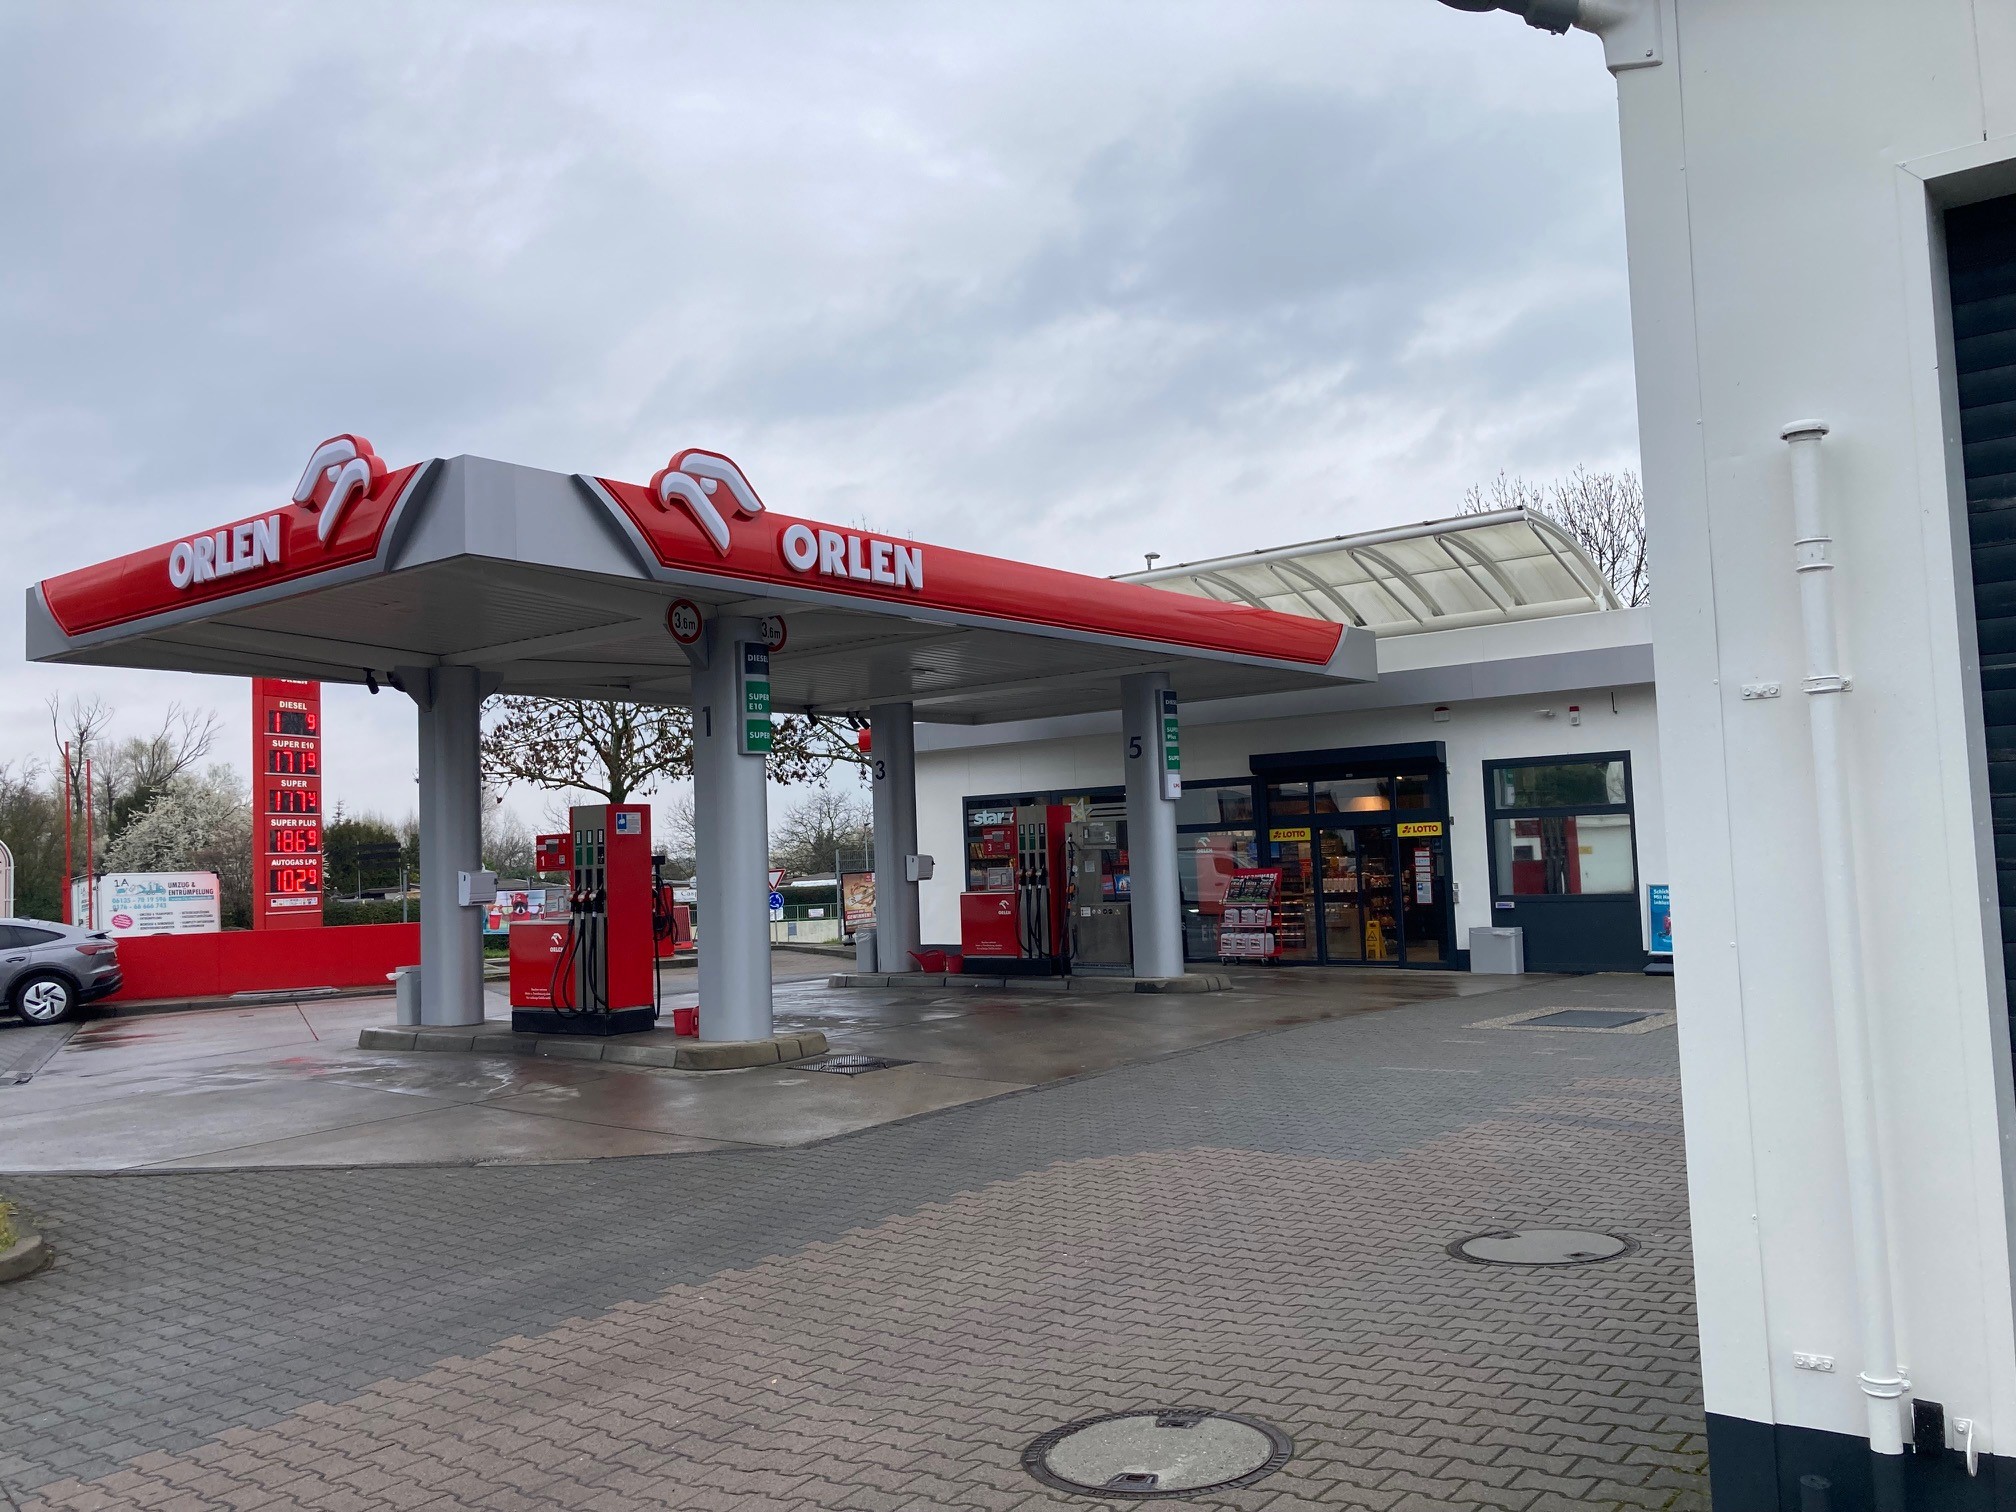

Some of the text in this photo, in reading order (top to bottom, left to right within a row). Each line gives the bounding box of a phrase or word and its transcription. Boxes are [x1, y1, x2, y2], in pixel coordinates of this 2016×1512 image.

[168, 514, 280, 590] ORLEN
[783, 523, 924, 591] ORLEN
[748, 692, 770, 701] SUPER
[279, 701, 307, 710] DIESEL
[749, 703, 763, 711] E10
[702, 706, 711, 737] 1
[749, 731, 771, 739] SUPER
[272, 739, 314, 749] SUPER E10
[1129, 735, 1142, 759] 5
[875, 760, 886, 780] 3
[281, 779, 307, 788] SUPER
[973, 809, 1005, 825] star
[271, 818, 317, 827] SUPER PLUS
[1412, 825, 1439, 833] LOTTO
[1104, 831, 1111, 842] 5
[1282, 830, 1306, 839] LOTTO
[988, 843, 993, 852] 3
[540, 855, 545, 866] 1
[168, 888, 214, 896] ENTRÜMPELUNG
